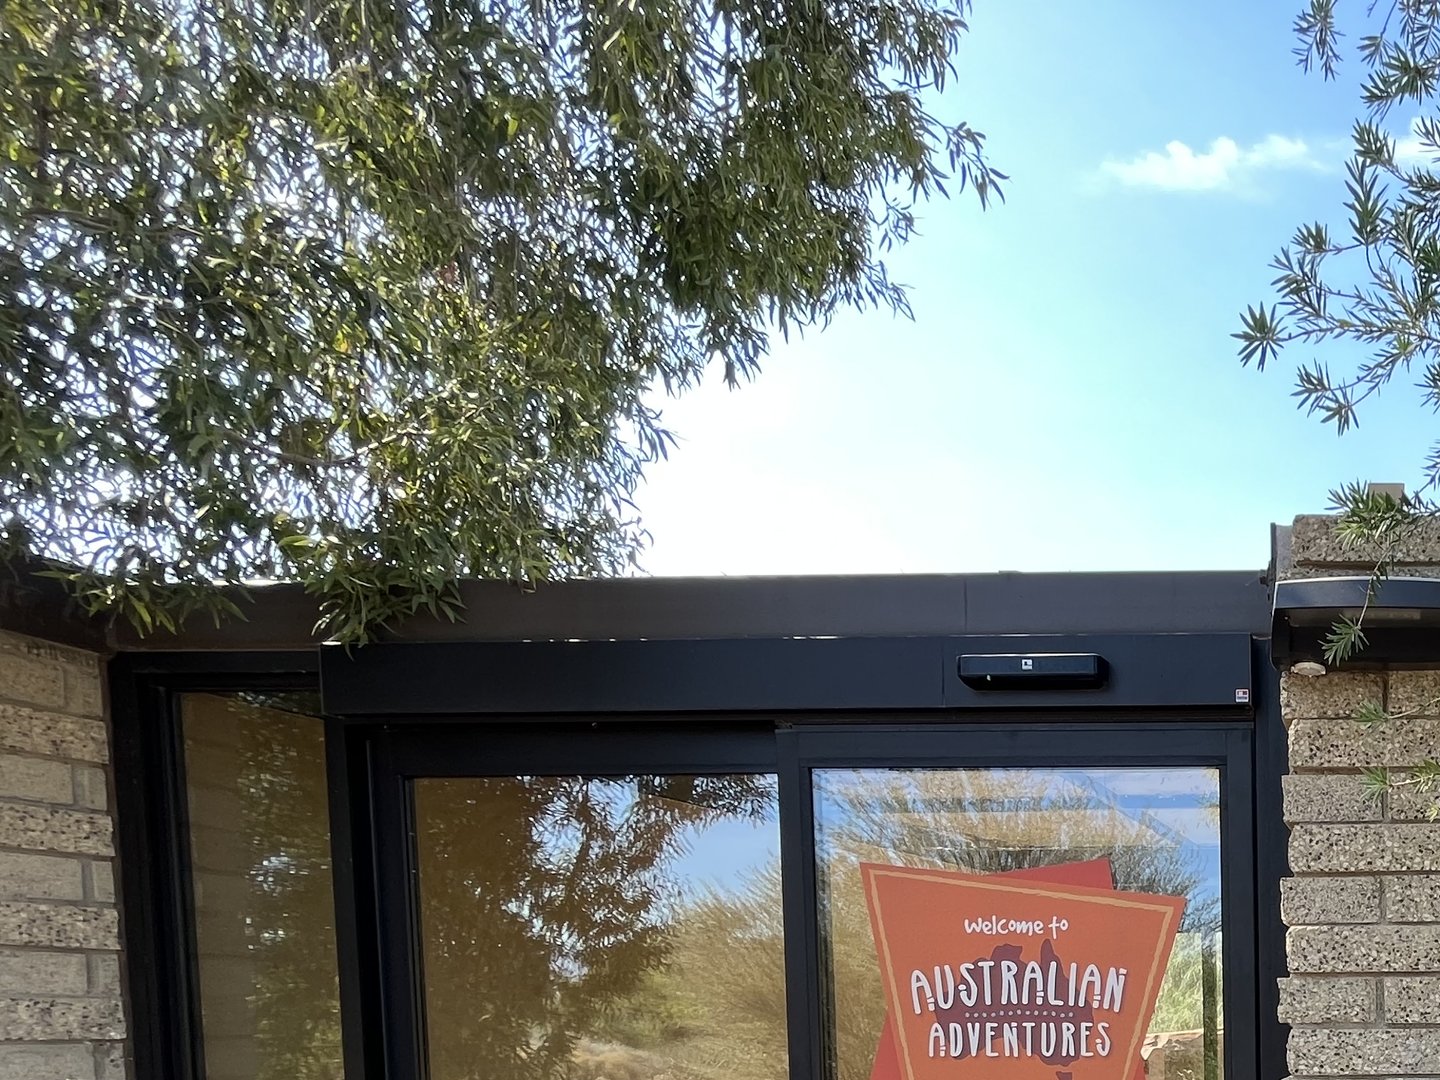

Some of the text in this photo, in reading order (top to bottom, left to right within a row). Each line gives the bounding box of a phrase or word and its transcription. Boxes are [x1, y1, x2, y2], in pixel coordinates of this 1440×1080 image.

[1048, 915, 1069, 940] to
[910, 961, 1127, 1014] AUSTRALIAN
[928, 1022, 1111, 1058] ADVENTURES
